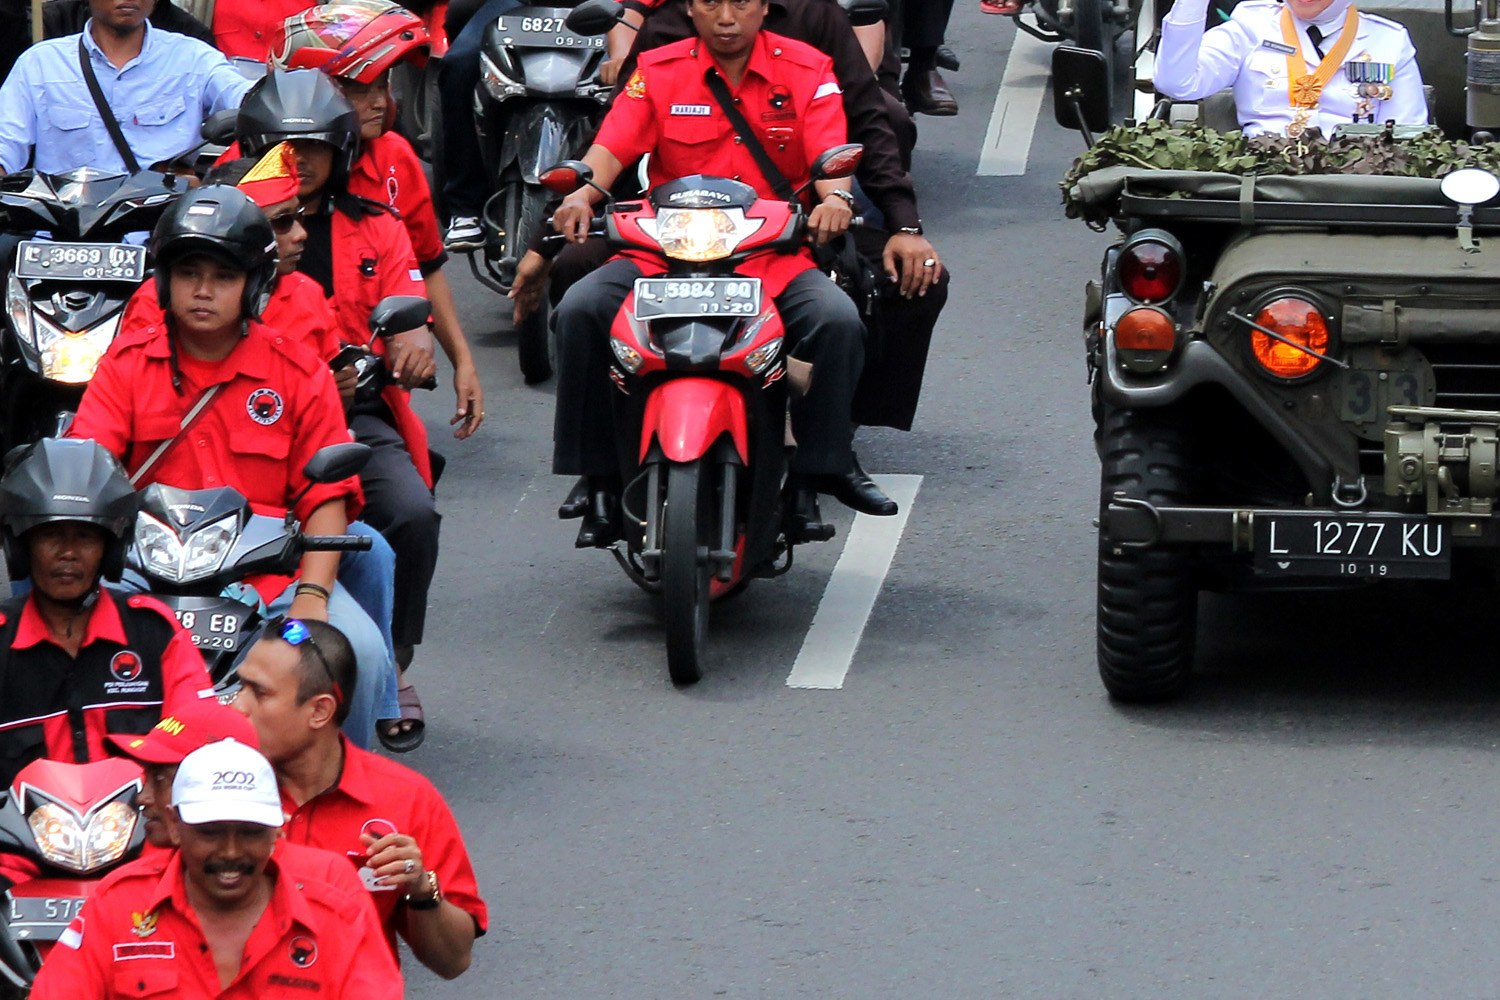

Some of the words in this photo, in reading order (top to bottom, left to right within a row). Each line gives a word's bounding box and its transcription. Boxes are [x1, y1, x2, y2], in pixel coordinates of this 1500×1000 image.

[498, 16, 508, 32] L
[522, 16, 565, 33] 6827
[669, 188, 733, 204] SURABAYA
[643, 284, 658, 300] L
[53, 494, 91, 503] HONDA
[168, 502, 206, 513] HONDA
[1270, 523, 1290, 553] L
[1313, 522, 1386, 555] 1277
[1402, 524, 1443, 556] KU
[1340, 562, 1357, 574] 10
[1370, 564, 1388, 576] 19
[210, 614, 238, 633] EB
[12, 899, 25, 920] L
